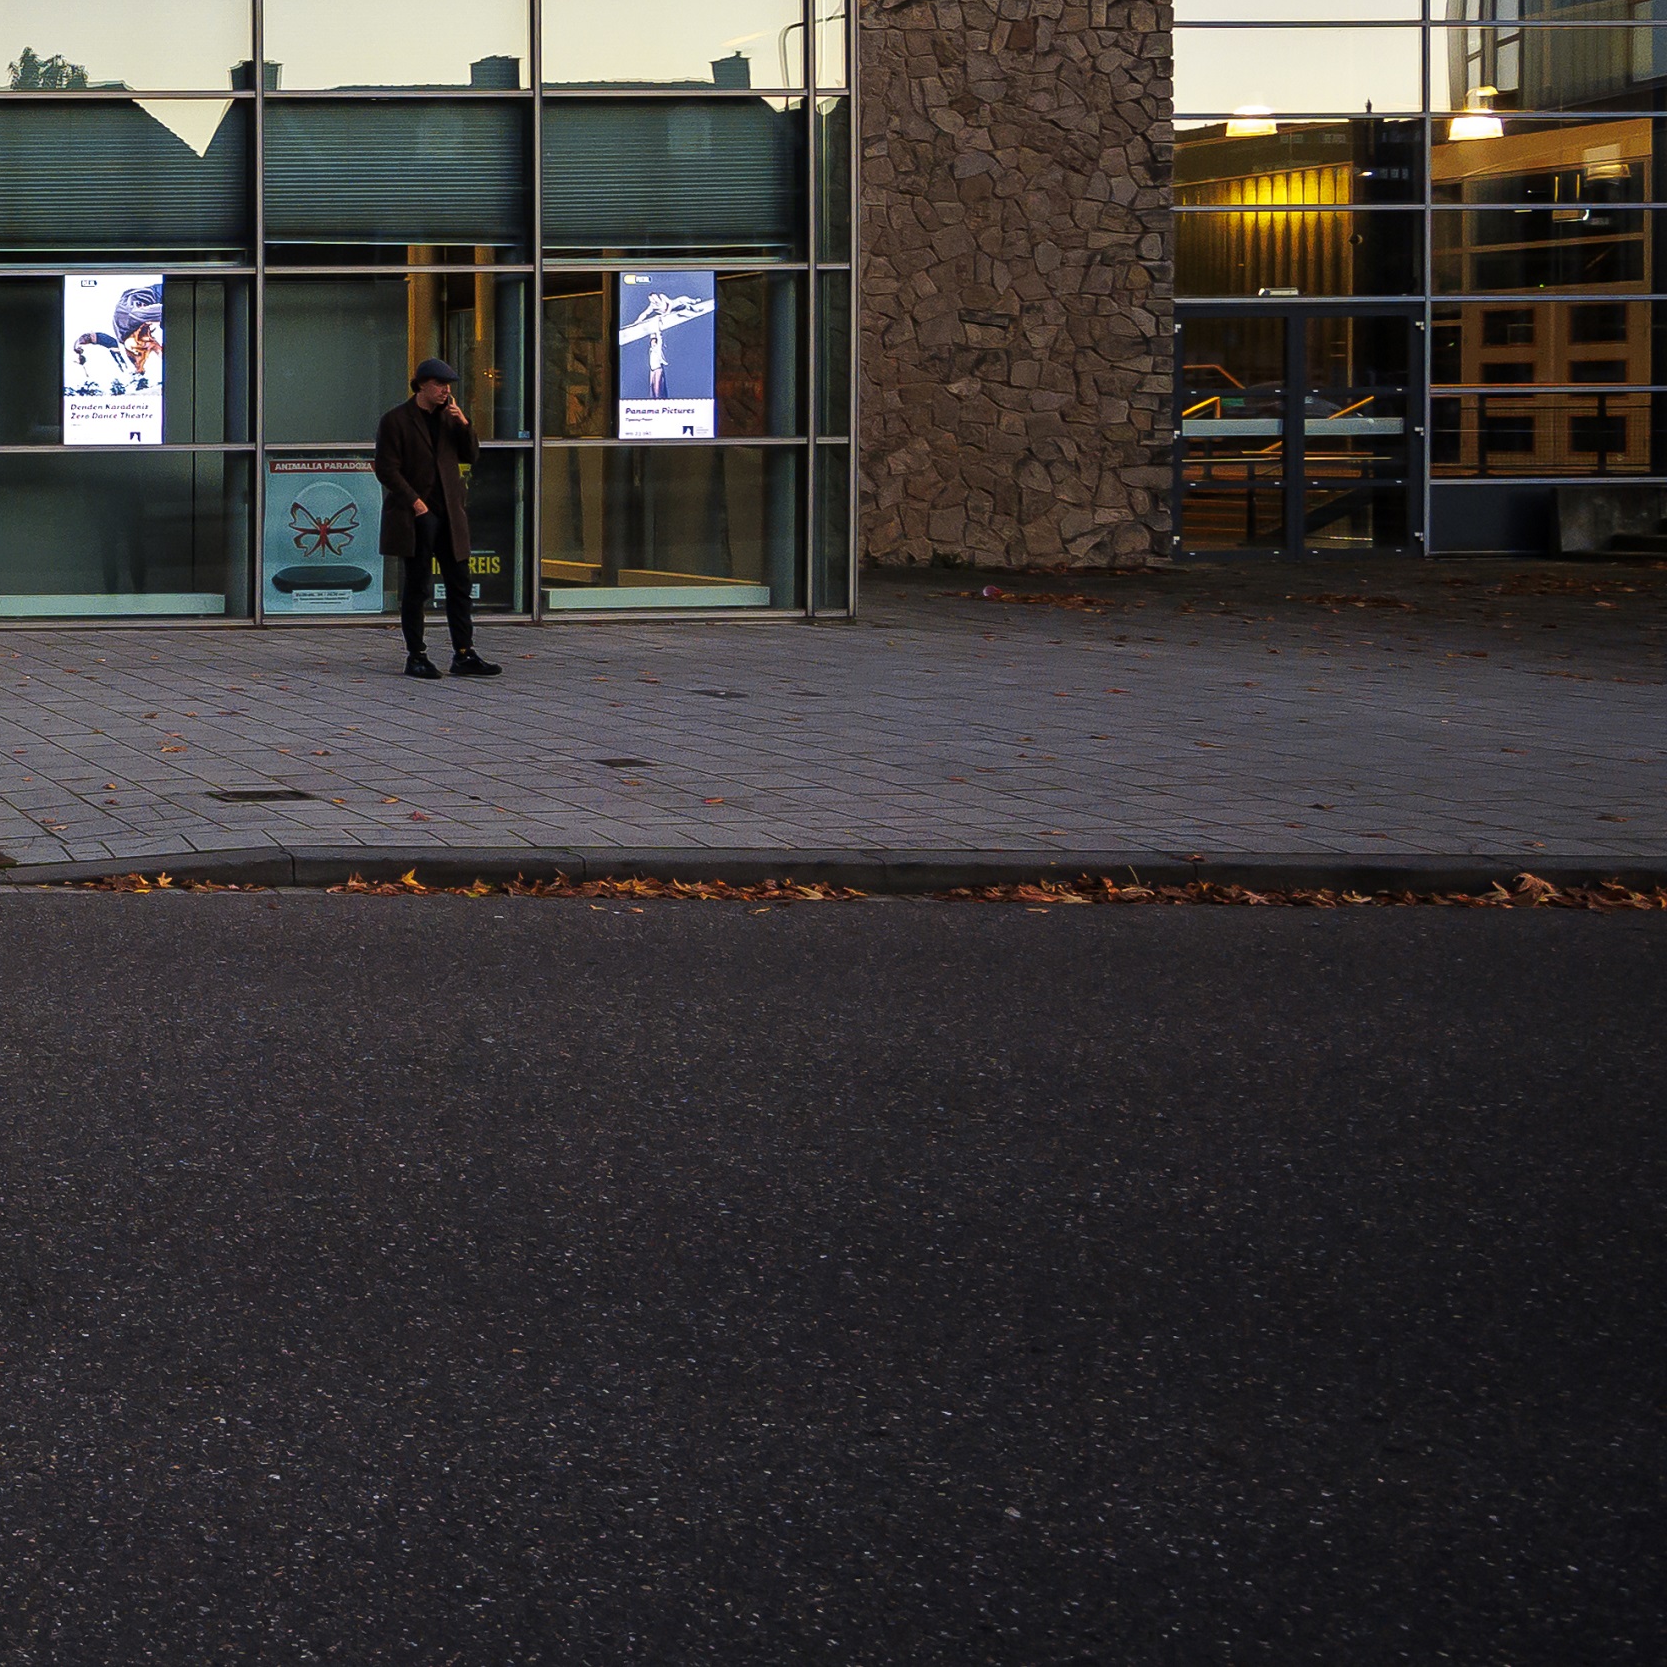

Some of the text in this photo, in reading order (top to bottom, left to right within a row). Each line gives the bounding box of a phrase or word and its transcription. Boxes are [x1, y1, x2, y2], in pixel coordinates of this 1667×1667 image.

[70, 403, 103, 411] Denden
[625, 406, 695, 415] Panama Pictures
[70, 412, 154, 420] Zero Dance Theatre
[274, 462, 373, 470] ANIMALIA PARADOXA
